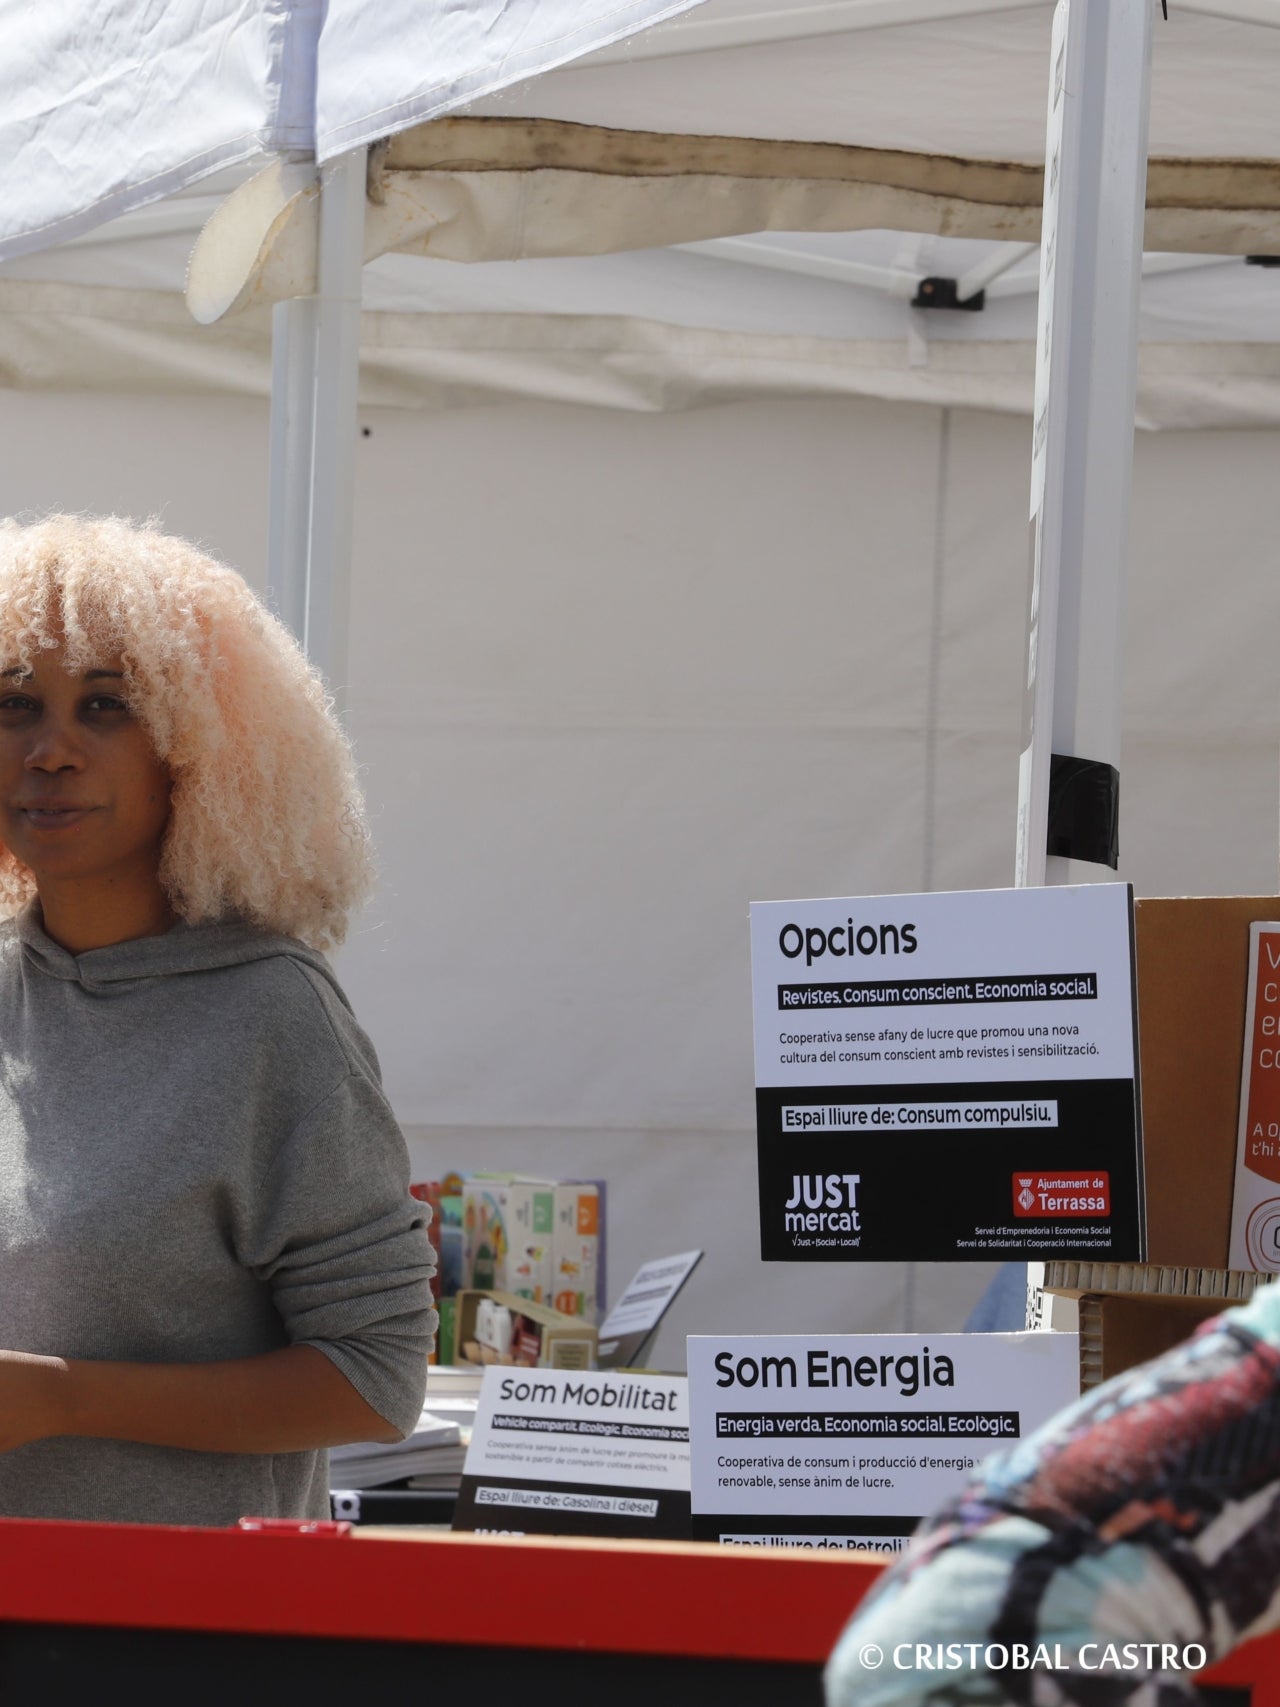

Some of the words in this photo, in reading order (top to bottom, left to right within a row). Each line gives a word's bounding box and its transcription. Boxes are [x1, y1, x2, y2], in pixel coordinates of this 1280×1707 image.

[779, 917, 918, 966] Opcions
[783, 988, 842, 1005] Revistes.
[843, 988, 900, 1004] Consum
[902, 983, 973, 1001] conscient.
[975, 980, 1047, 999] Economia
[1049, 977, 1094, 996] social.
[779, 1031, 842, 1046] Cooperativa
[845, 1032, 875, 1042] sense
[878, 1029, 908, 1042] afany
[910, 1028, 924, 1040] de
[927, 1027, 954, 1039] lucre
[957, 1029, 977, 1041] que
[981, 1026, 1024, 1040] promou
[1028, 1026, 1049, 1036] una
[1052, 1025, 1079, 1036] nova
[780, 1051, 817, 1063] cultura
[820, 1051, 836, 1062] del
[839, 1051, 881, 1062] consum
[884, 1048, 935, 1060] conscient
[939, 1047, 964, 1059] amb
[966, 1046, 1009, 1058] revistes
[1011, 1045, 1015, 1057] i
[1018, 1043, 1099, 1057] sensibilització.
[786, 1108, 825, 1129] Espai
[829, 1107, 868, 1125] lliure
[871, 1107, 895, 1125] de:
[898, 1107, 961, 1124] Consum
[964, 1103, 1051, 1125] compulsiu.
[785, 1174, 860, 1209] JUST
[1037, 1178, 1089, 1191] Ajuntament
[1092, 1178, 1104, 1189] de
[1038, 1192, 1105, 1210] Terrassa
[785, 1210, 861, 1232] mercat
[974, 1226, 995, 1235] Servei
[996, 1226, 1049, 1236] d'Emprenedoria
[1055, 1226, 1089, 1235] Economia
[1090, 1226, 1111, 1235] Social
[956, 1239, 977, 1248] Servei
[978, 1239, 987, 1248] de
[988, 1239, 1022, 1247] Solidaritat
[1026, 1238, 1065, 1249] Cooperació
[1066, 1238, 1112, 1248] Internacional
[714, 1352, 797, 1388] Som
[807, 1346, 954, 1396] Energia
[500, 1379, 556, 1404] Som
[562, 1382, 678, 1412] Mobilitat
[493, 1415, 528, 1429] Vehicle
[622, 1424, 670, 1439] Economia
[718, 1416, 774, 1436] Energia
[776, 1416, 822, 1432] verda.
[825, 1416, 898, 1432] Economia
[900, 1416, 946, 1432] social.
[948, 1415, 1015, 1436] Ecològic.
[484, 1451, 524, 1462] sostenible
[532, 1454, 554, 1466] partir
[555, 1456, 565, 1465] de
[567, 1457, 604, 1469] compartir
[606, 1460, 632, 1470] cotxes
[487, 1440, 533, 1452] Cooperativa
[535, 1443, 557, 1452] sense
[580, 1445, 590, 1454] de
[592, 1446, 612, 1456] lucre
[614, 1448, 626, 1459] per
[628, 1449, 668, 1461] promoure
[670, 1450, 677, 1460] la
[717, 1456, 784, 1470] Cooperativa
[787, 1456, 802, 1468] de
[804, 1458, 850, 1468] consum
[859, 1456, 916, 1470] producció
[920, 1456, 974, 1470] d'energia
[718, 1475, 776, 1488] renovable,
[778, 1477, 810, 1488] sense
[814, 1476, 842, 1488] ànim
[845, 1476, 860, 1488] de
[862, 1476, 894, 1488] lucre.
[479, 1489, 510, 1504] Espai
[511, 1492, 542, 1505] lliure
[543, 1493, 560, 1506] de:
[562, 1496, 611, 1510] Gasolina
[618, 1500, 654, 1514] dièsel.
